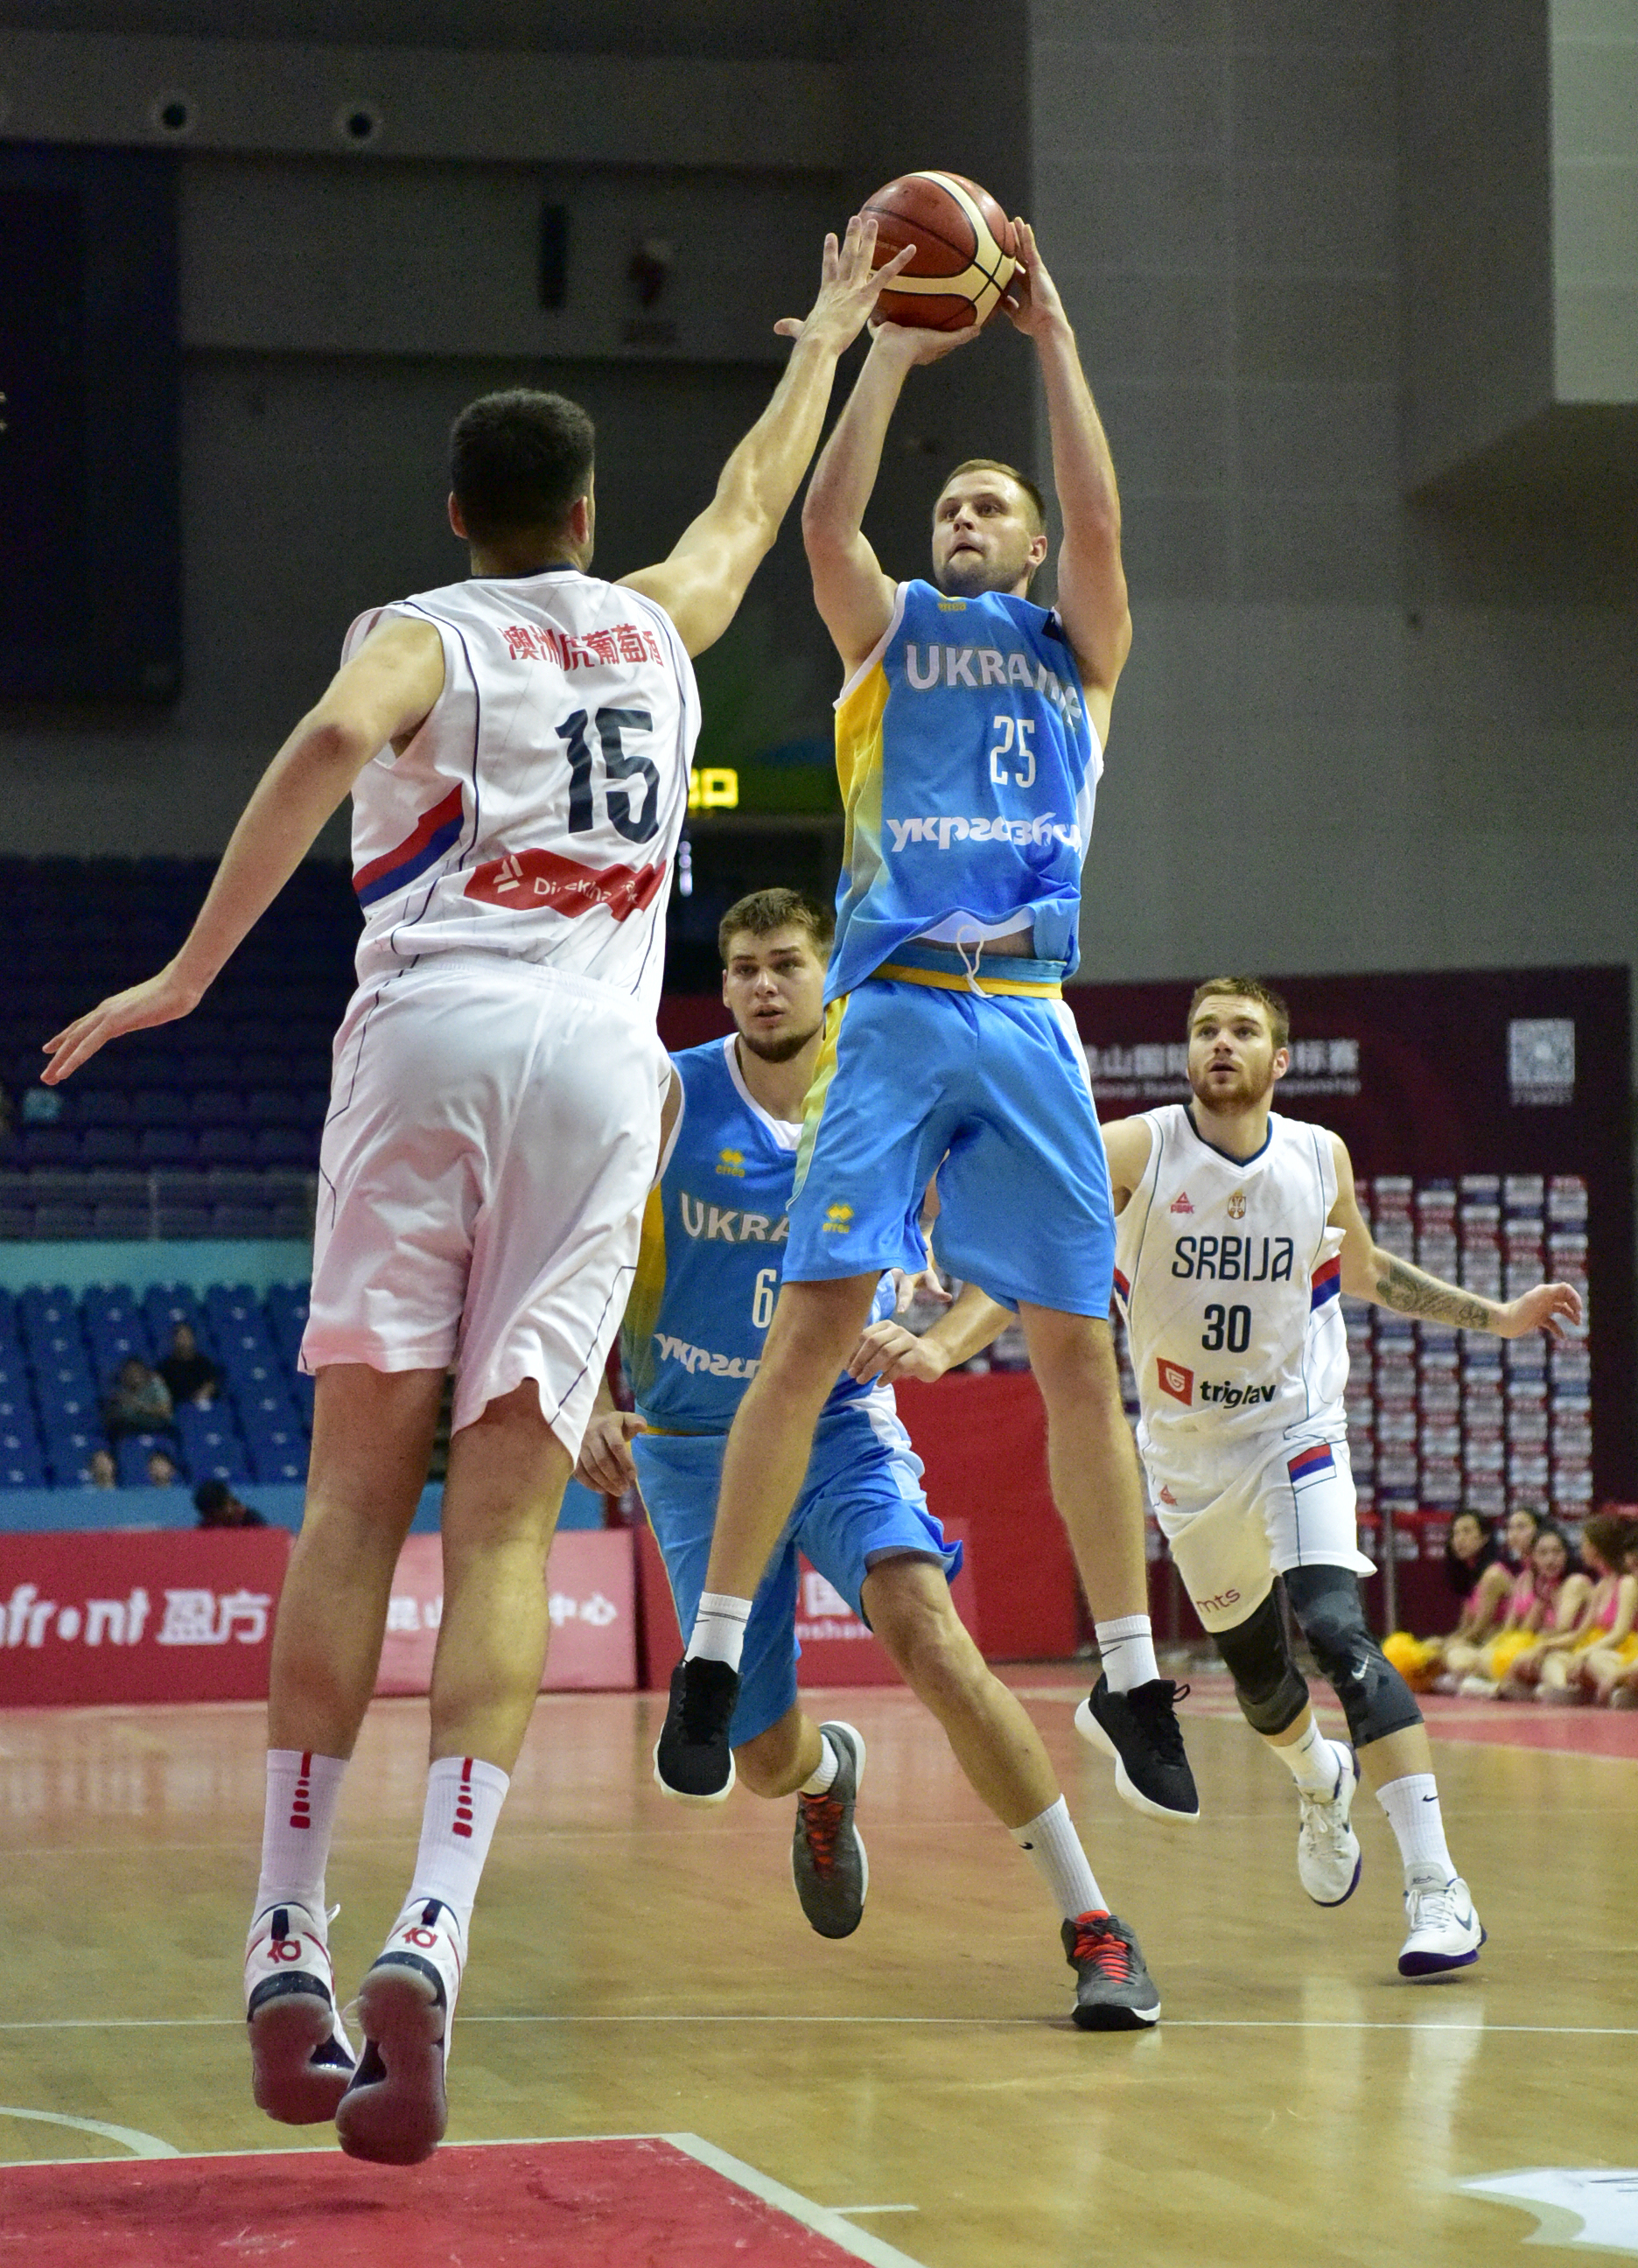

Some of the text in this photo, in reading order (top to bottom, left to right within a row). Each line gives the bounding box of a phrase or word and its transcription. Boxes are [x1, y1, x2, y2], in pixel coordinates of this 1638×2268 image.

[555, 708, 661, 844] 15
[990, 716, 1036, 788] 25
[681, 1192, 789, 1242] UKRA
[752, 1269, 776, 1327] 6
[1201, 1304, 1251, 1353] 30
[1200, 1381, 1276, 1409] triglav
[0, 1584, 150, 1648] front
[1197, 1589, 1241, 1614] mts
